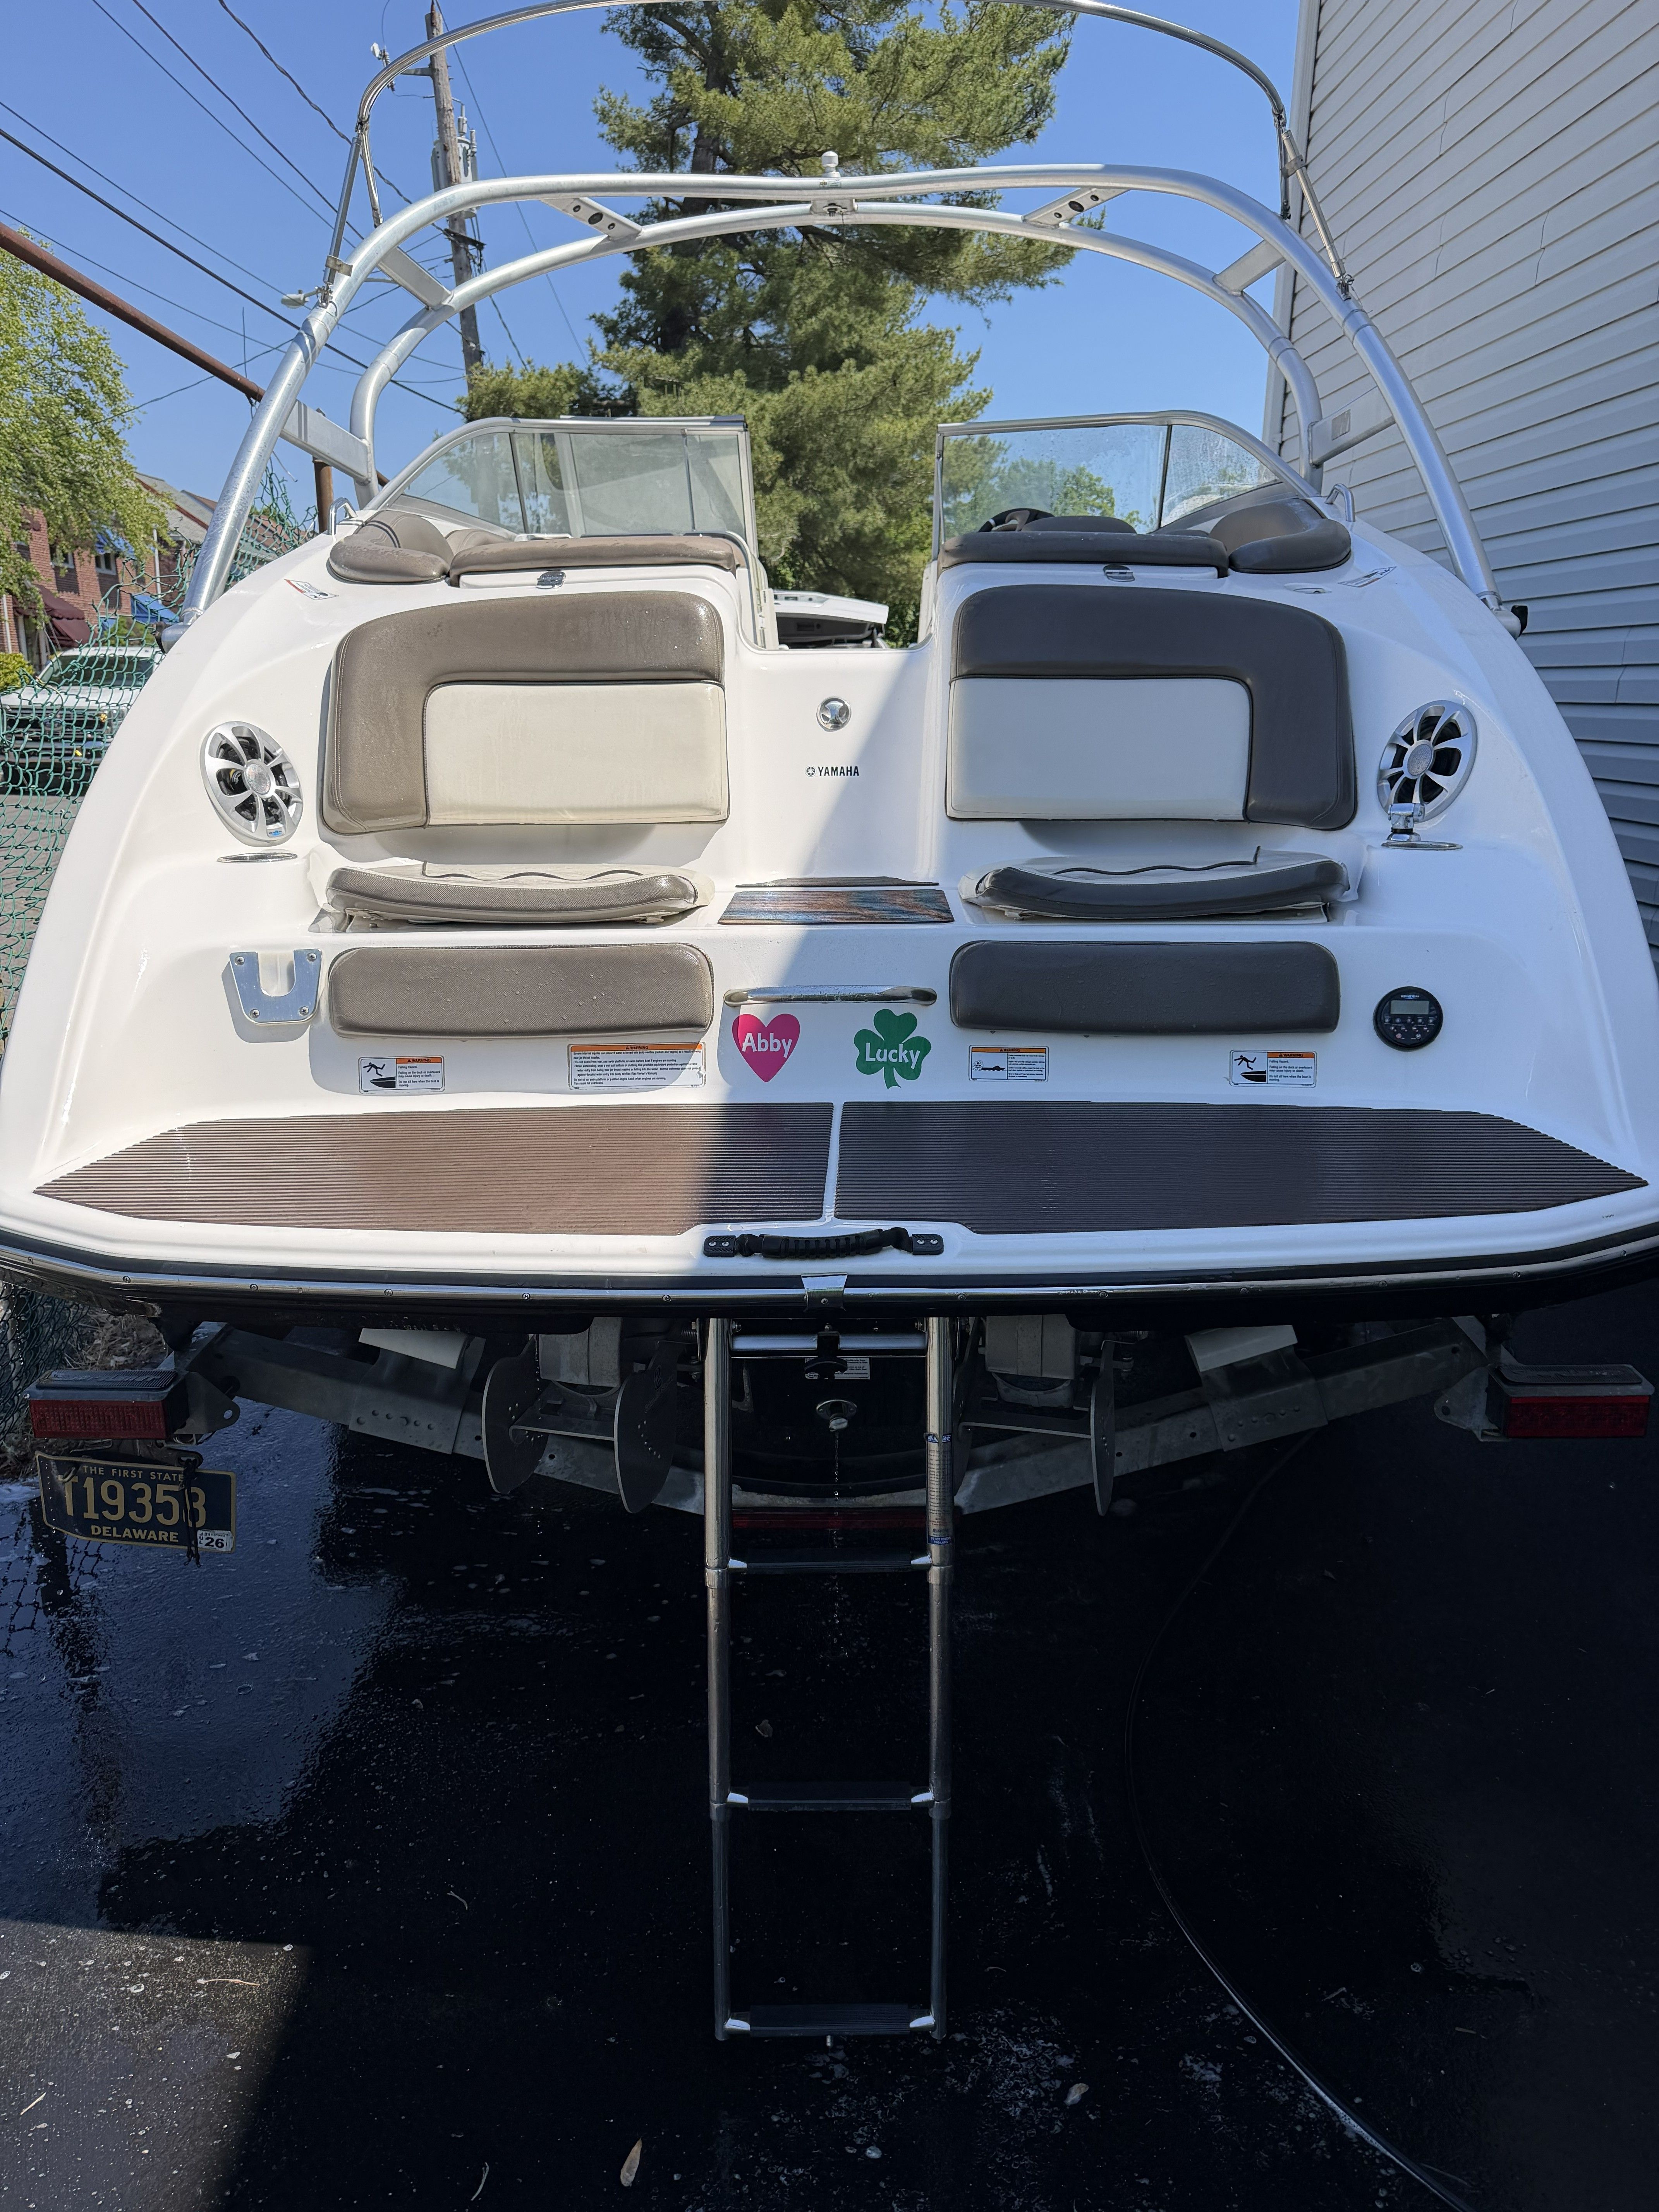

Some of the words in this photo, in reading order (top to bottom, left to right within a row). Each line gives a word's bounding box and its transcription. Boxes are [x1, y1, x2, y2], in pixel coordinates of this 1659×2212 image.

[818, 766, 859, 776] YAMAHA
[742, 1033, 792, 1058] Abby
[866, 1042, 921, 1069] Lucky
[83, 1465, 104, 1475] THE
[112, 1468, 143, 1479] FIRST
[150, 1472, 184, 1482] STATE
[91, 1525, 179, 1543] DELAWARE
[204, 1537, 225, 1548] 26
